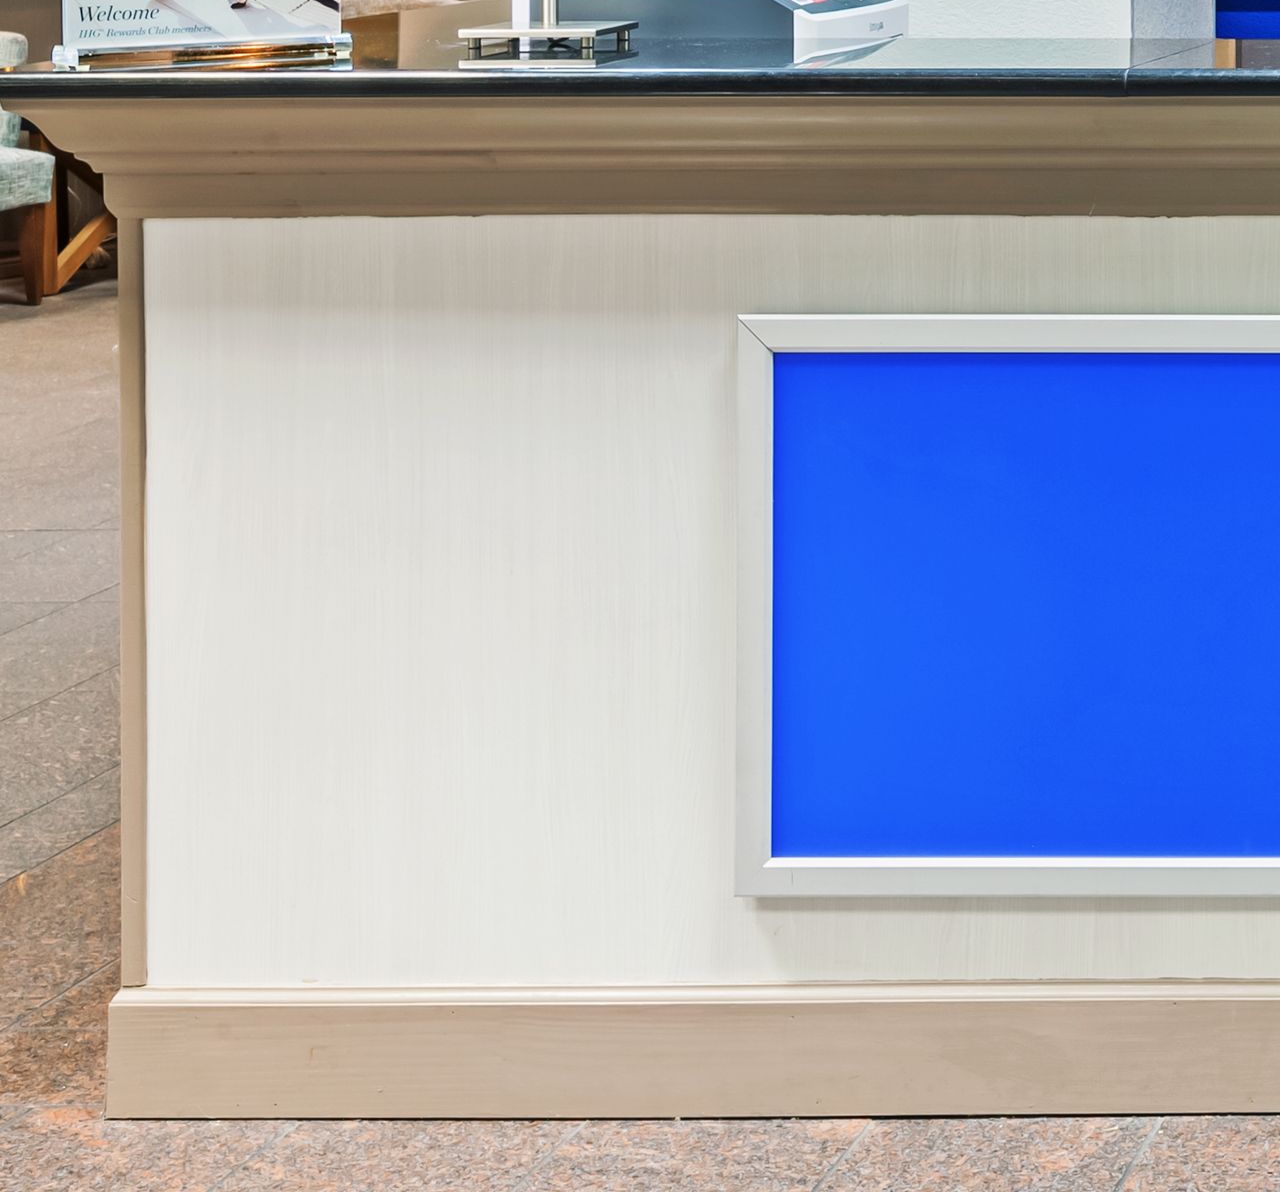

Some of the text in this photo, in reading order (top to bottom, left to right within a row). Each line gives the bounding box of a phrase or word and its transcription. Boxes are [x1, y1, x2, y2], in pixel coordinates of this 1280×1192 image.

[79, 5, 160, 22] Welcome
[79, 25, 212, 39] IHG Rewards Club members
